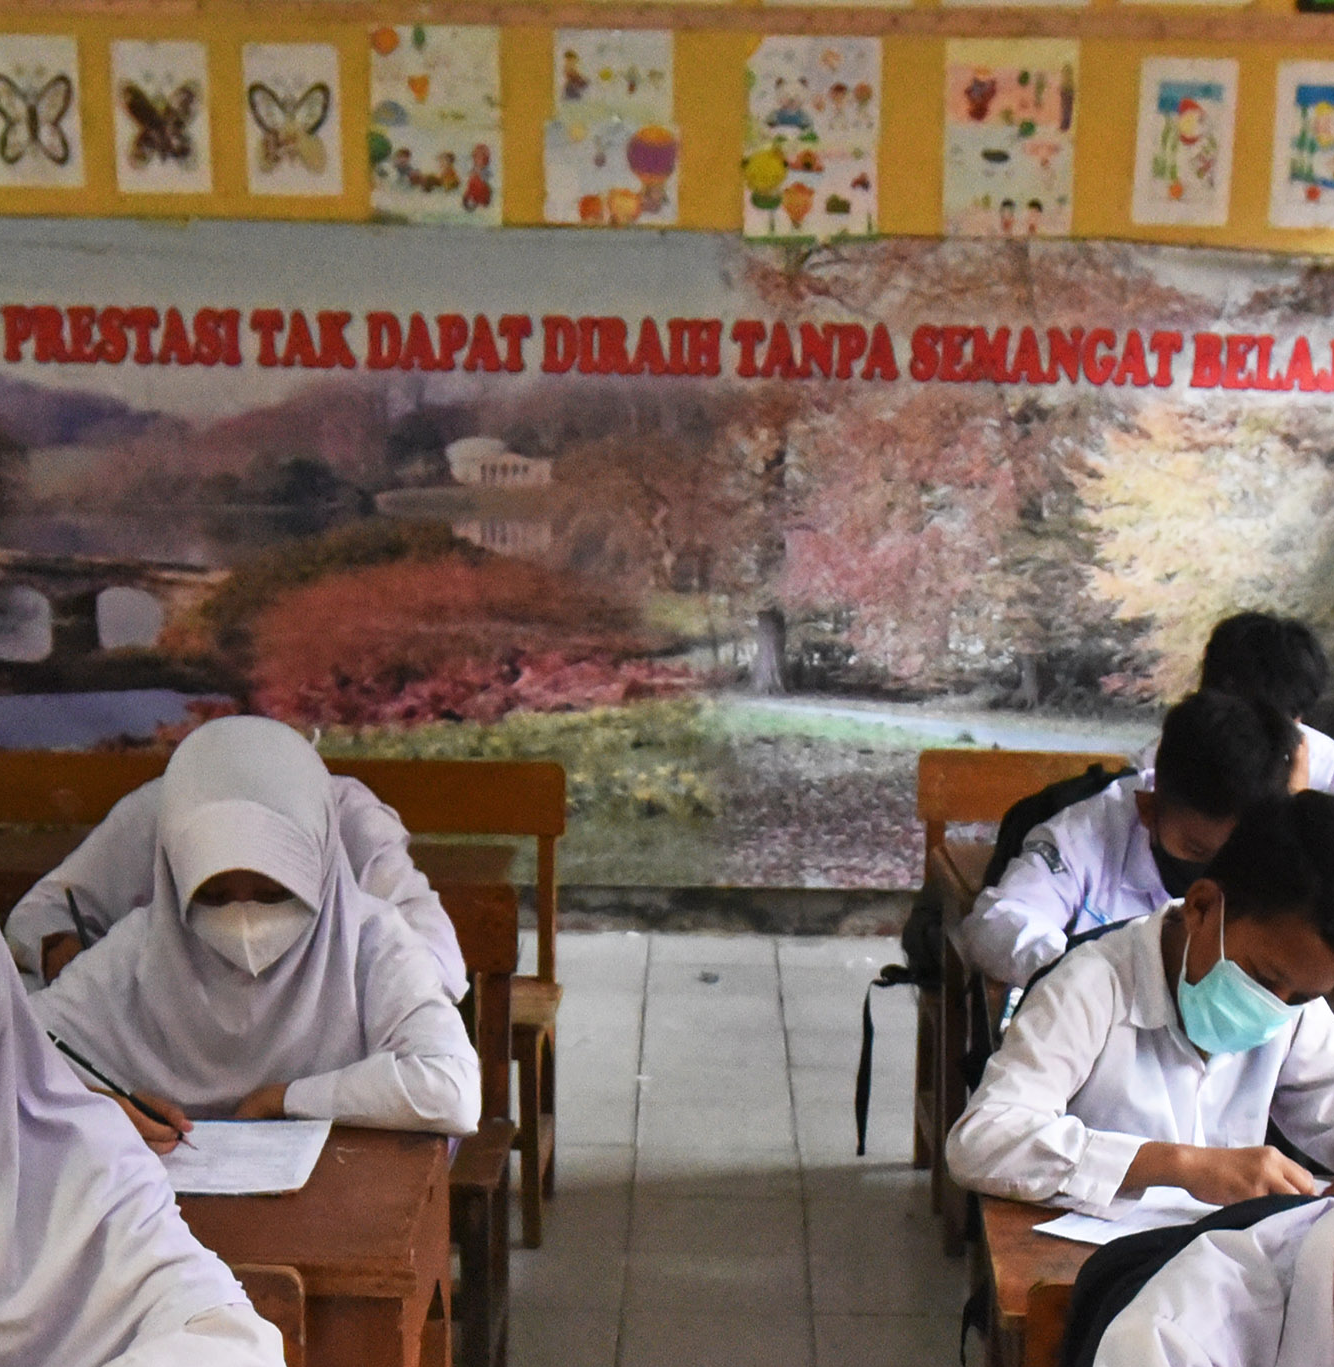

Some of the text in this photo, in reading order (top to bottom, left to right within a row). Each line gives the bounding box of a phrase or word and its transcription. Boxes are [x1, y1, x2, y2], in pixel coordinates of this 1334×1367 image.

[2, 305, 242, 366] PRESTASI
[251, 310, 357, 369] TAK
[366, 311, 533, 373] DAPAT
[542, 316, 722, 377] DIRAIH
[732, 319, 898, 381] TANPA
[910, 324, 1183, 388] SEMANGAT
